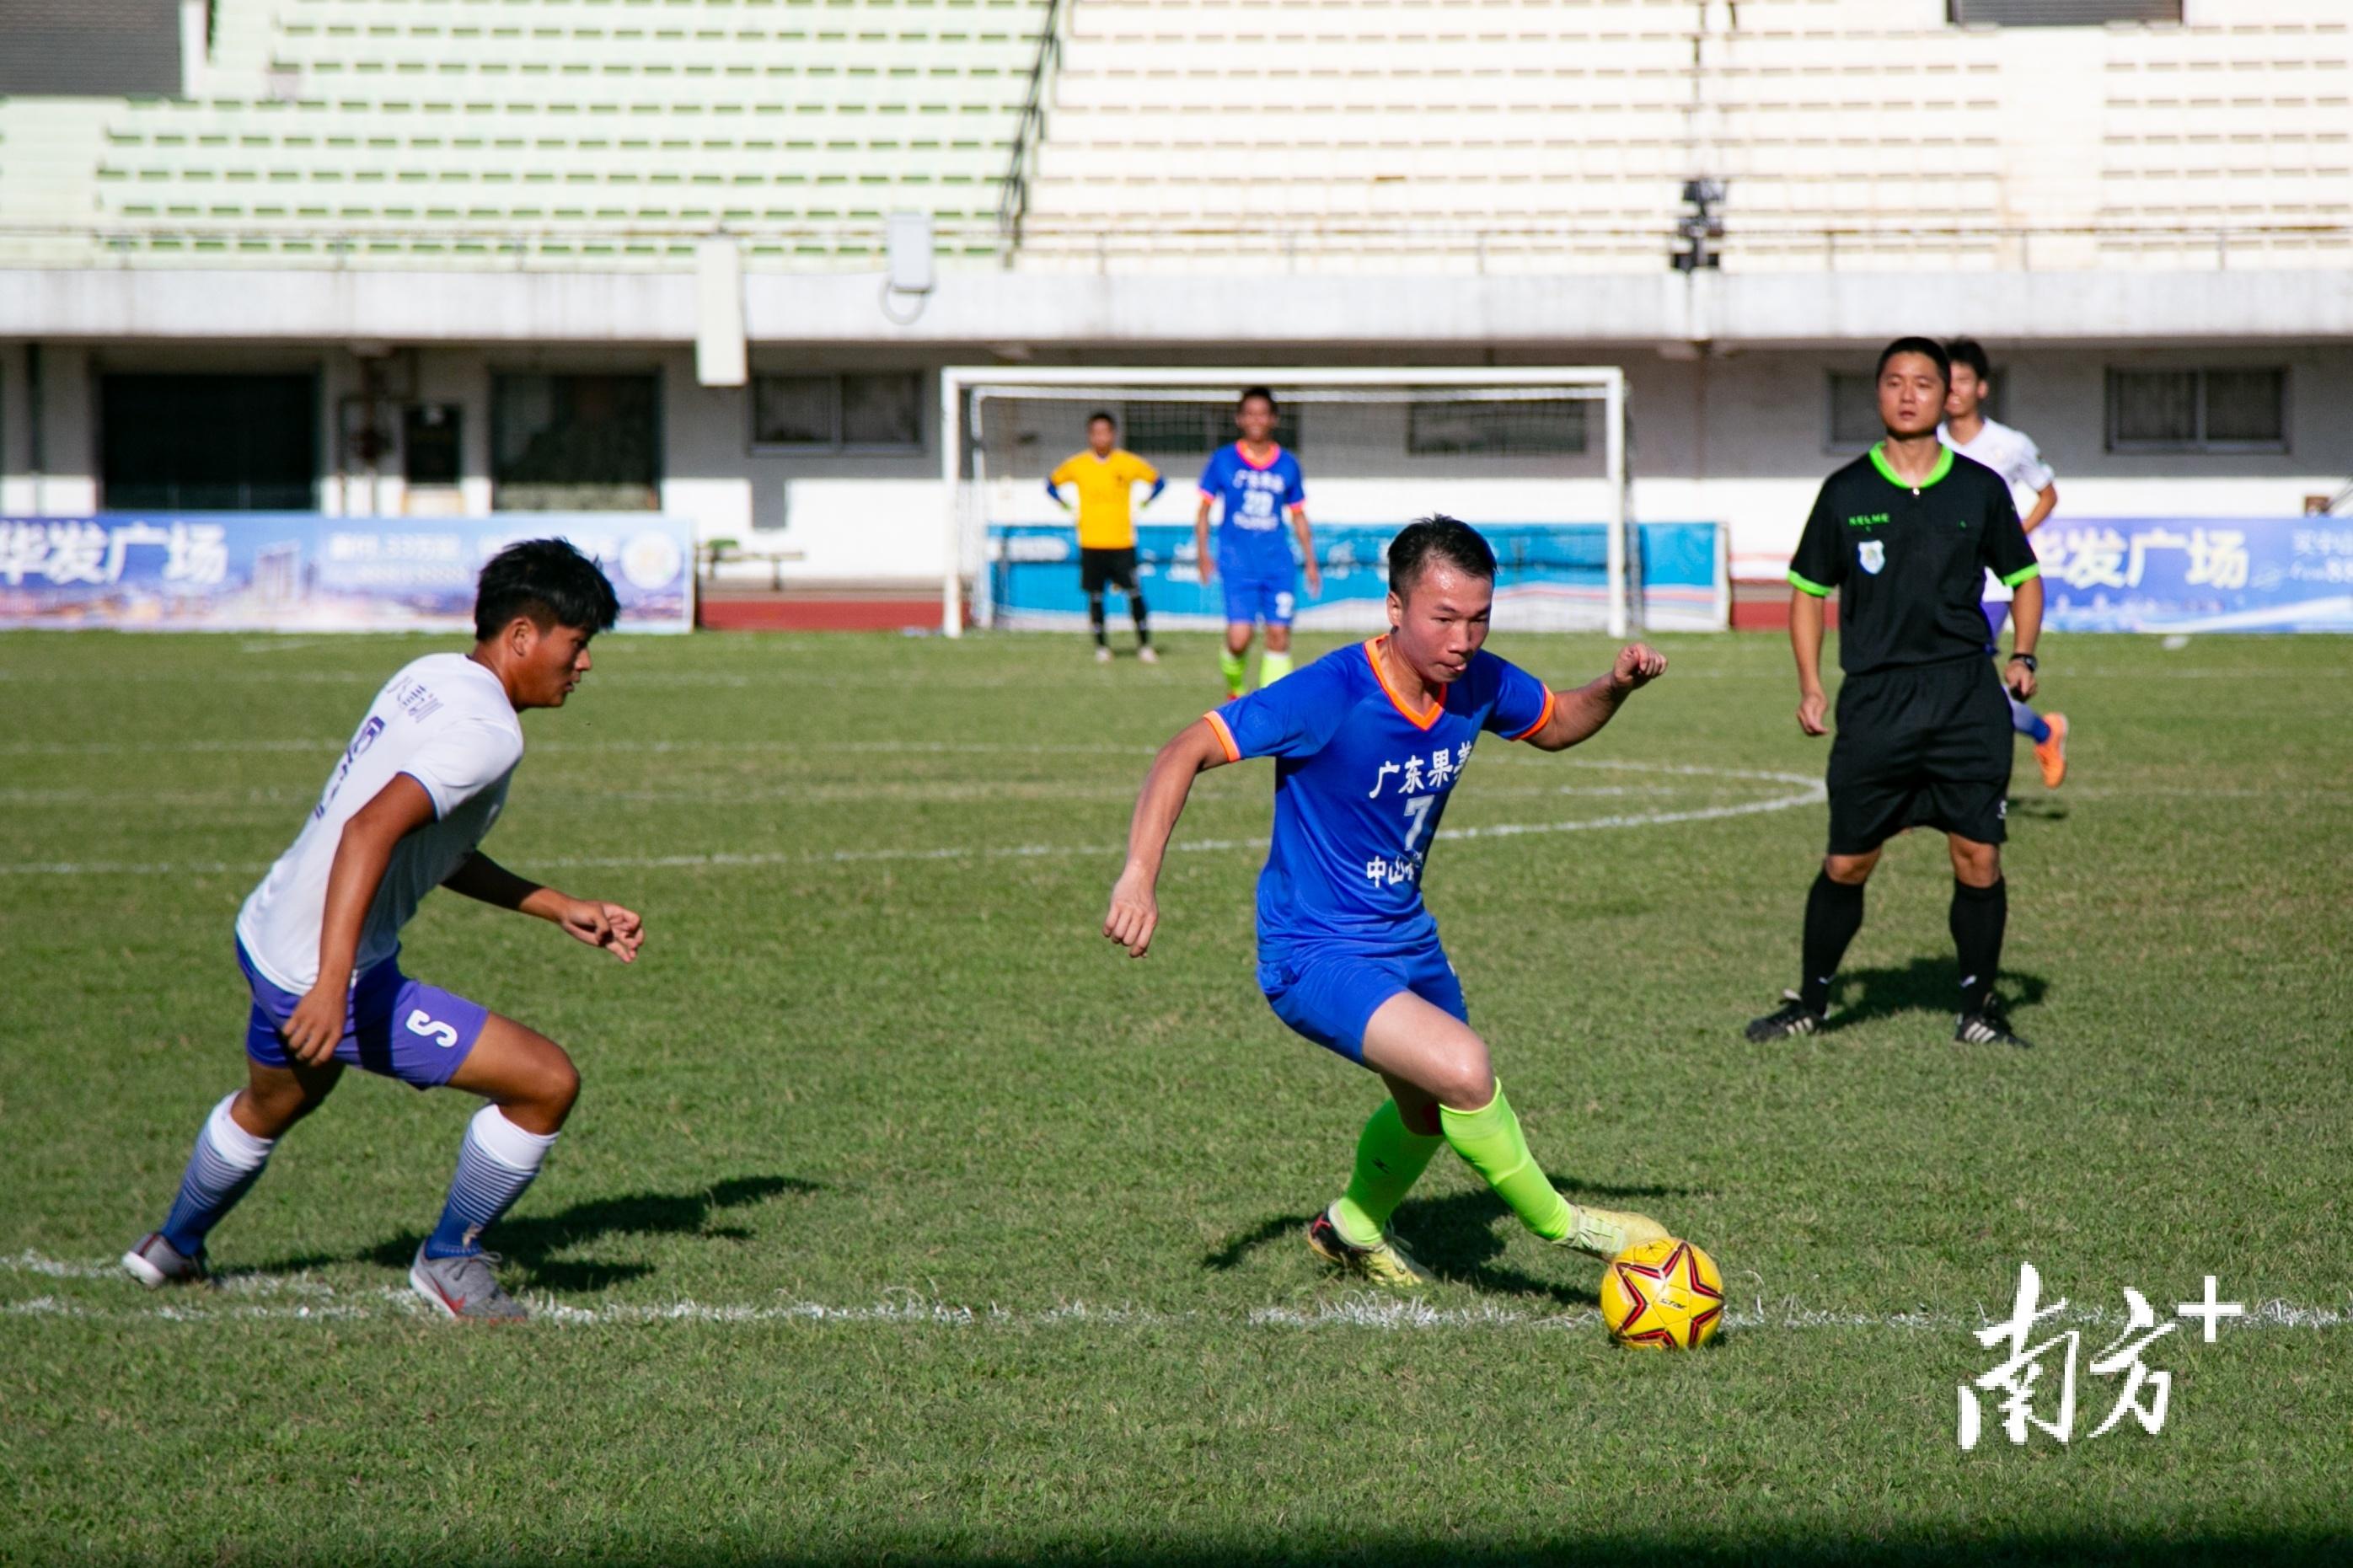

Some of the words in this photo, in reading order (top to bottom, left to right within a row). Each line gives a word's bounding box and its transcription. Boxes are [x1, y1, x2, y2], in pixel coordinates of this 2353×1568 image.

[0, 520, 228, 586] 华发广场
[1403, 795, 1434, 851] 7
